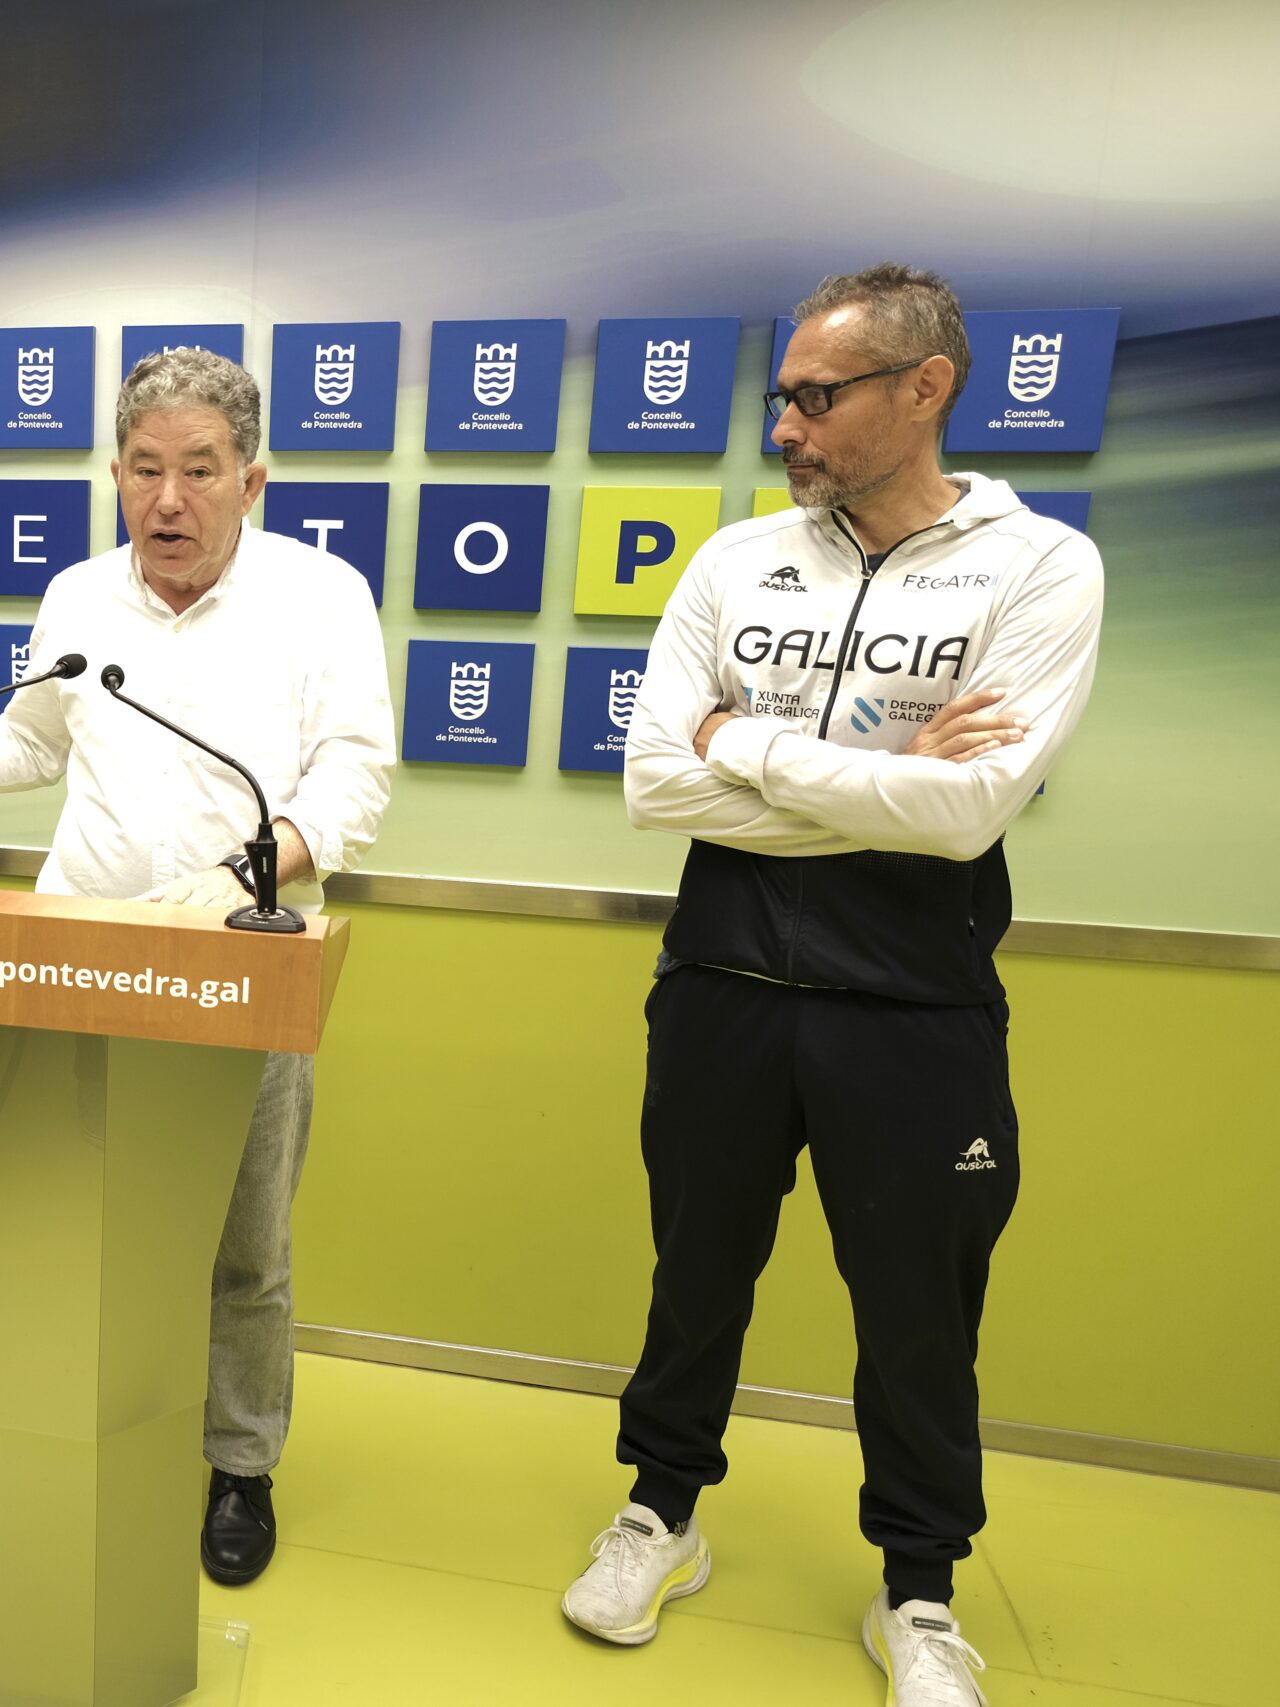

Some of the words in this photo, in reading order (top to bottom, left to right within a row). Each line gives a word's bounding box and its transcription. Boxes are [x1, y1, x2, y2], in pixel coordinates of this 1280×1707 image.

[17, 411, 52, 420] Concello
[313, 411, 351, 420] Concello
[471, 412, 511, 421] Concello
[641, 411, 682, 420] Concello
[1004, 409, 1050, 418] Concello
[7, 420, 18, 429] de
[18, 420, 63, 429] Pontevedra
[301, 420, 313, 429] de
[313, 420, 363, 429] Pontevedra
[458, 421, 471, 430] de
[471, 421, 523, 430] Pontevedra
[627, 420, 640, 430] de
[641, 420, 695, 430] Pontevedra
[988, 419, 1002, 428] de
[1003, 419, 1065, 428] Pontevedra
[13, 514, 48, 564] E
[453, 521, 509, 575] O
[614, 519, 677, 585] P
[733, 625, 969, 681] GALICIA
[756, 690, 801, 705] XUNTA
[755, 702, 772, 715] DE
[890, 699, 946, 713] DEPORT
[888, 710, 934, 723] GALEG
[448, 725, 486, 735] Concello
[435, 733, 447, 742] de
[448, 734, 498, 744] Pontevedra
[593, 742, 606, 751] de
[954, 1159, 998, 1171] austral
